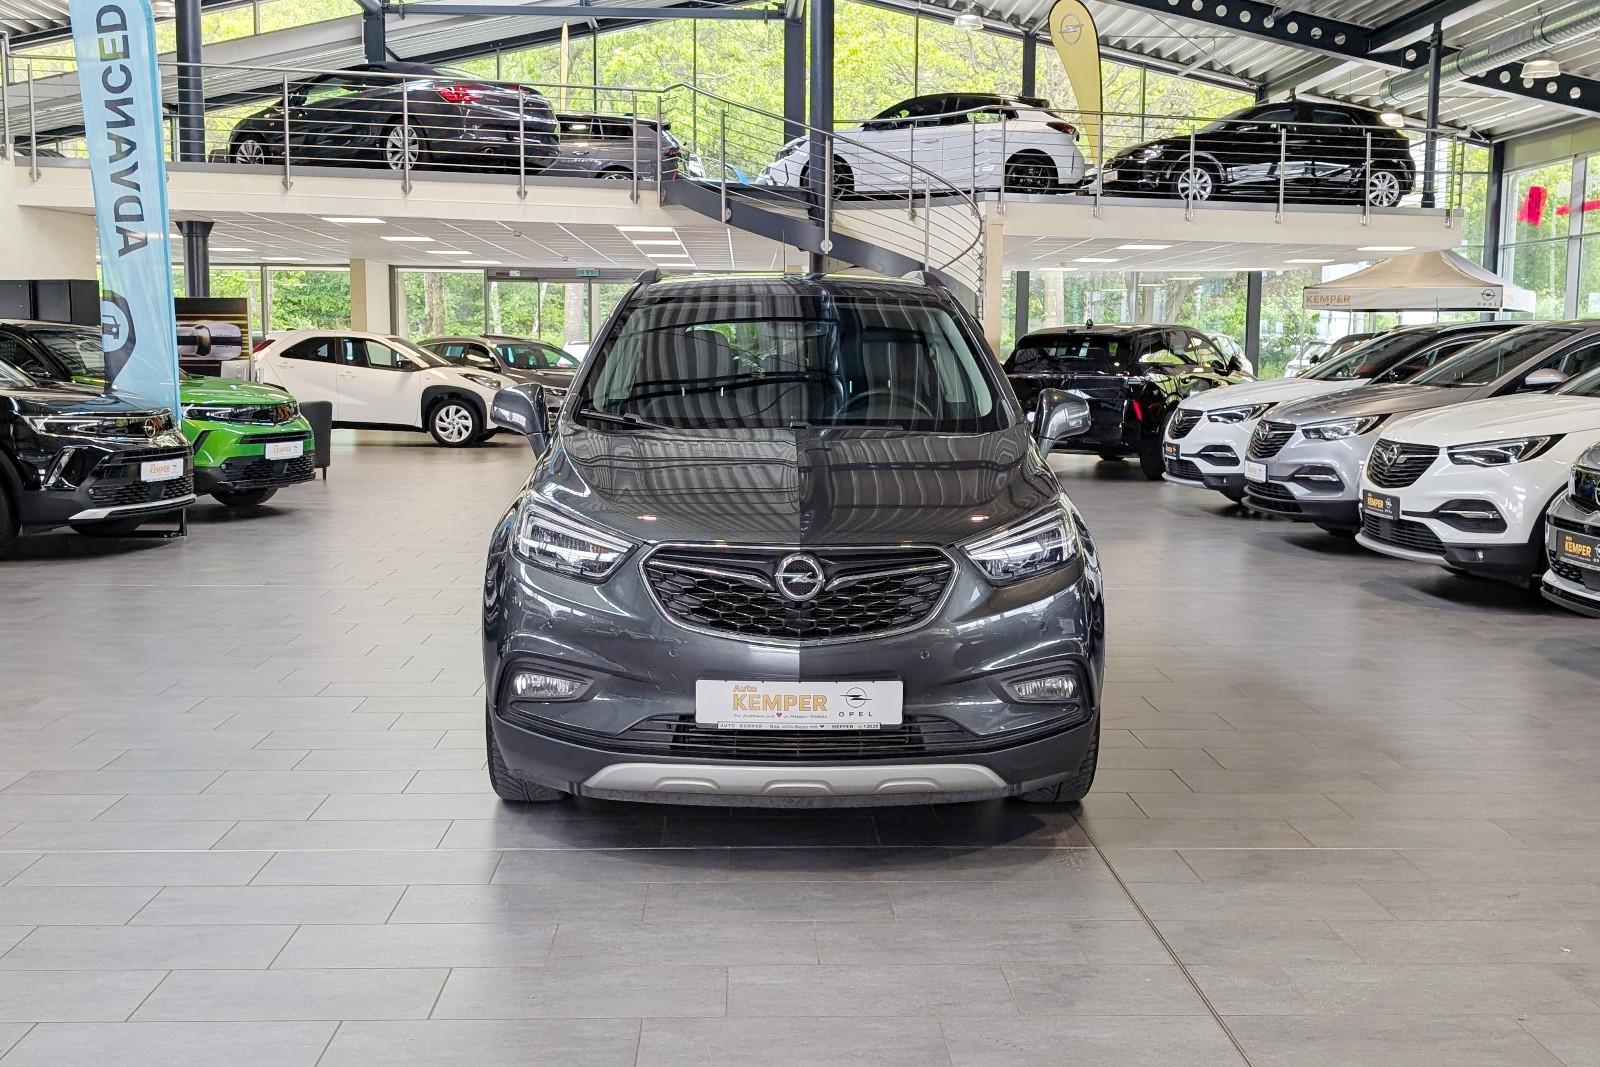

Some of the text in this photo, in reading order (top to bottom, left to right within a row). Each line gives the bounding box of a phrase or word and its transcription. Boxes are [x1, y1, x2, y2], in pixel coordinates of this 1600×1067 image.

[1306, 295, 1351, 303] KEMPER
[1564, 541, 1592, 557] KEMPER
[732, 693, 828, 711] KEMPER
